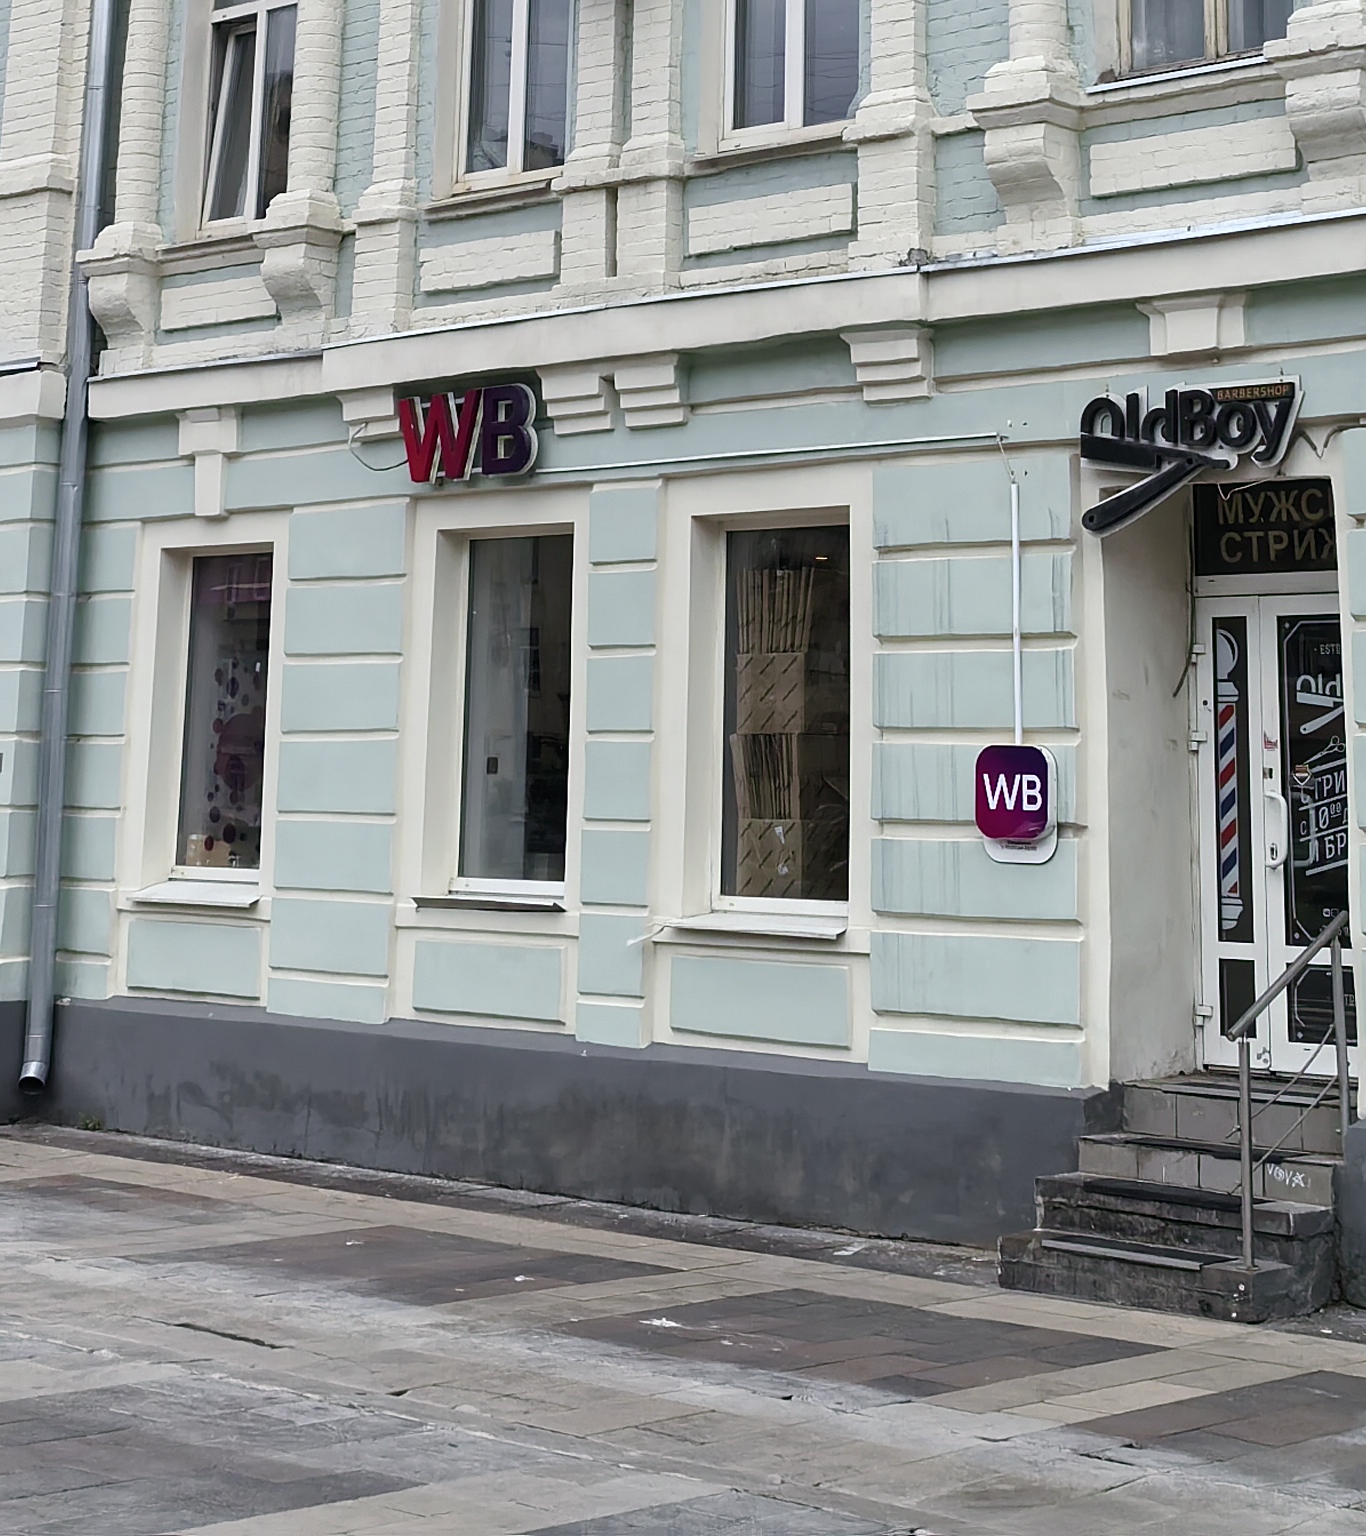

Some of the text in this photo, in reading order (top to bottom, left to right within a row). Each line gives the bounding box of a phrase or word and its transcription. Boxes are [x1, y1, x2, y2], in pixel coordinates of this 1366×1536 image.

[1217, 384, 1289, 401] BARBERSHOP
[399, 383, 539, 484] WB
[1081, 389, 1295, 463] OldBoy
[1217, 487, 1333, 525] МУЖС
[982, 773, 1043, 811] WB
